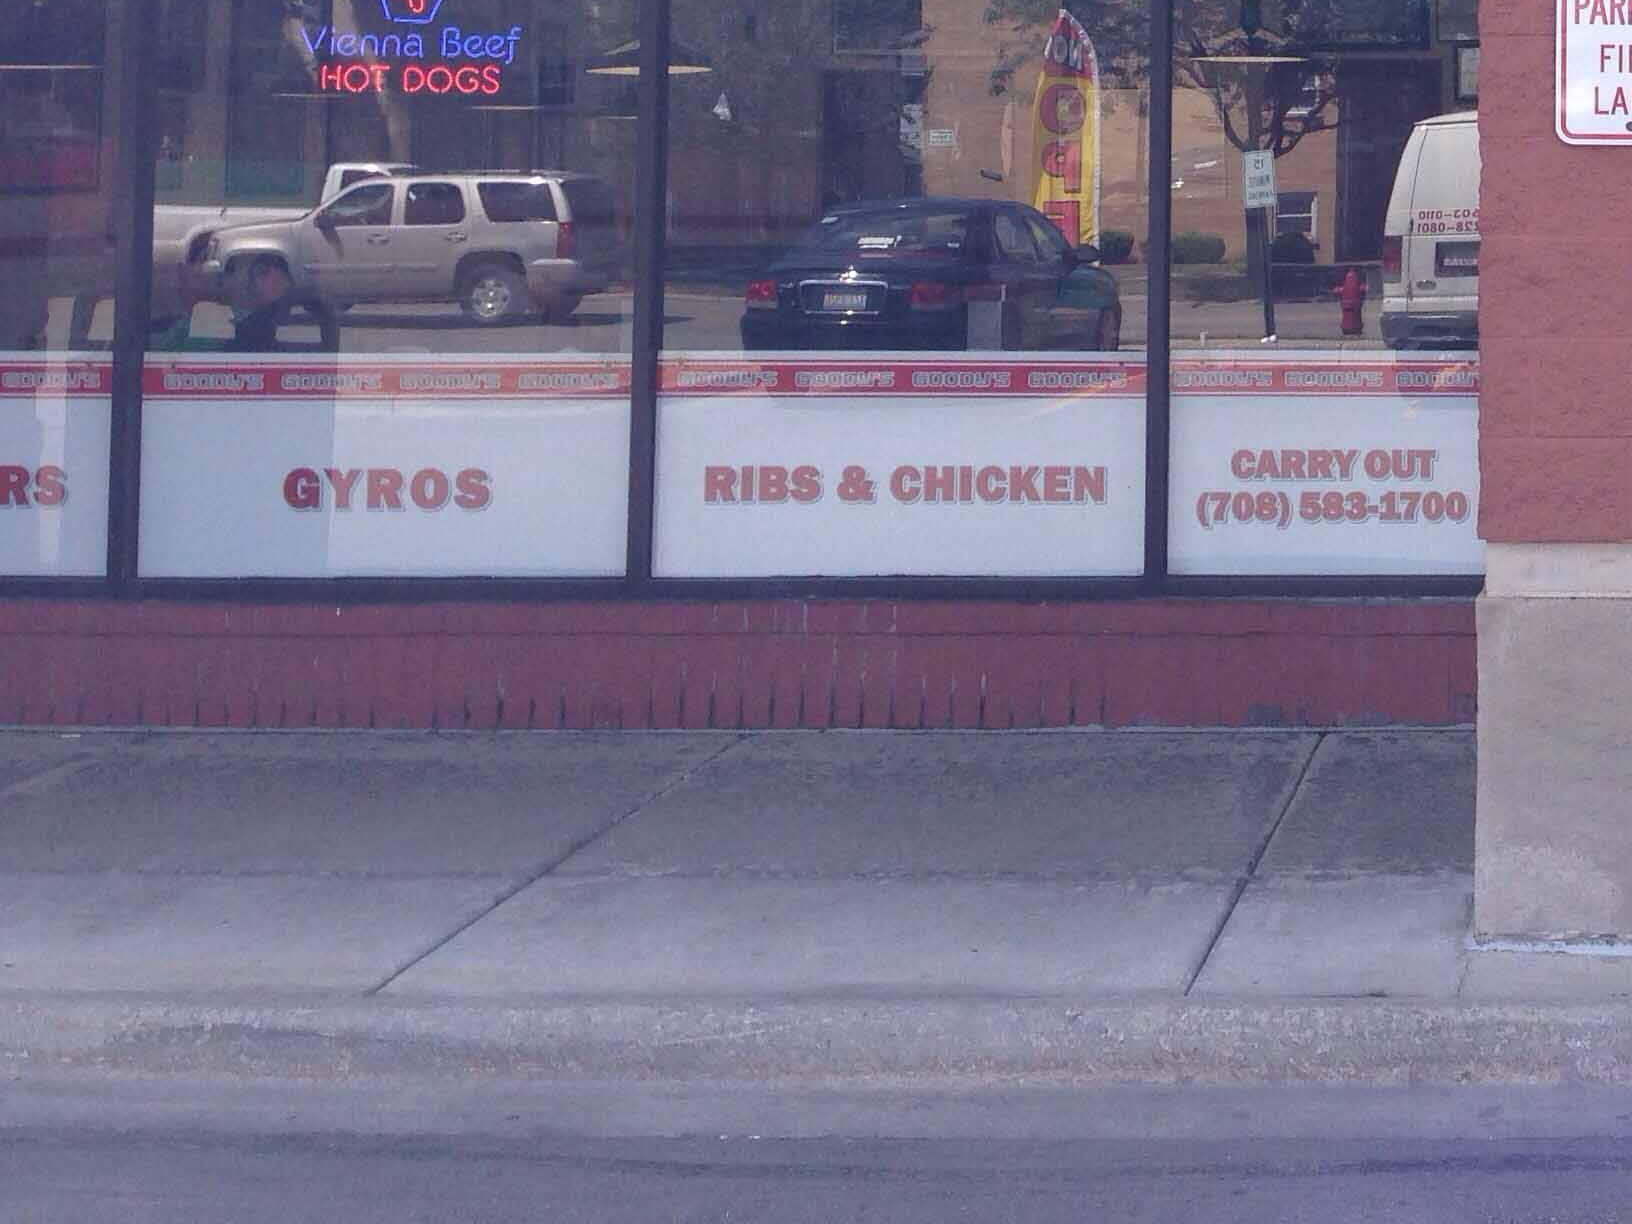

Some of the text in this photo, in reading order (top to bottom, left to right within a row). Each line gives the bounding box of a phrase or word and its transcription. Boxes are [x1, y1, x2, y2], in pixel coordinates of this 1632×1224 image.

[301, 26, 522, 64] Vienna Beef
[320, 64, 501, 95] HOT DOGS
[1230, 449, 1438, 481] CARRY OUT
[283, 467, 493, 511] GYROS
[704, 465, 1107, 504] RIBS & CHICKEN
[1196, 491, 1470, 529] (708) 583-1700
